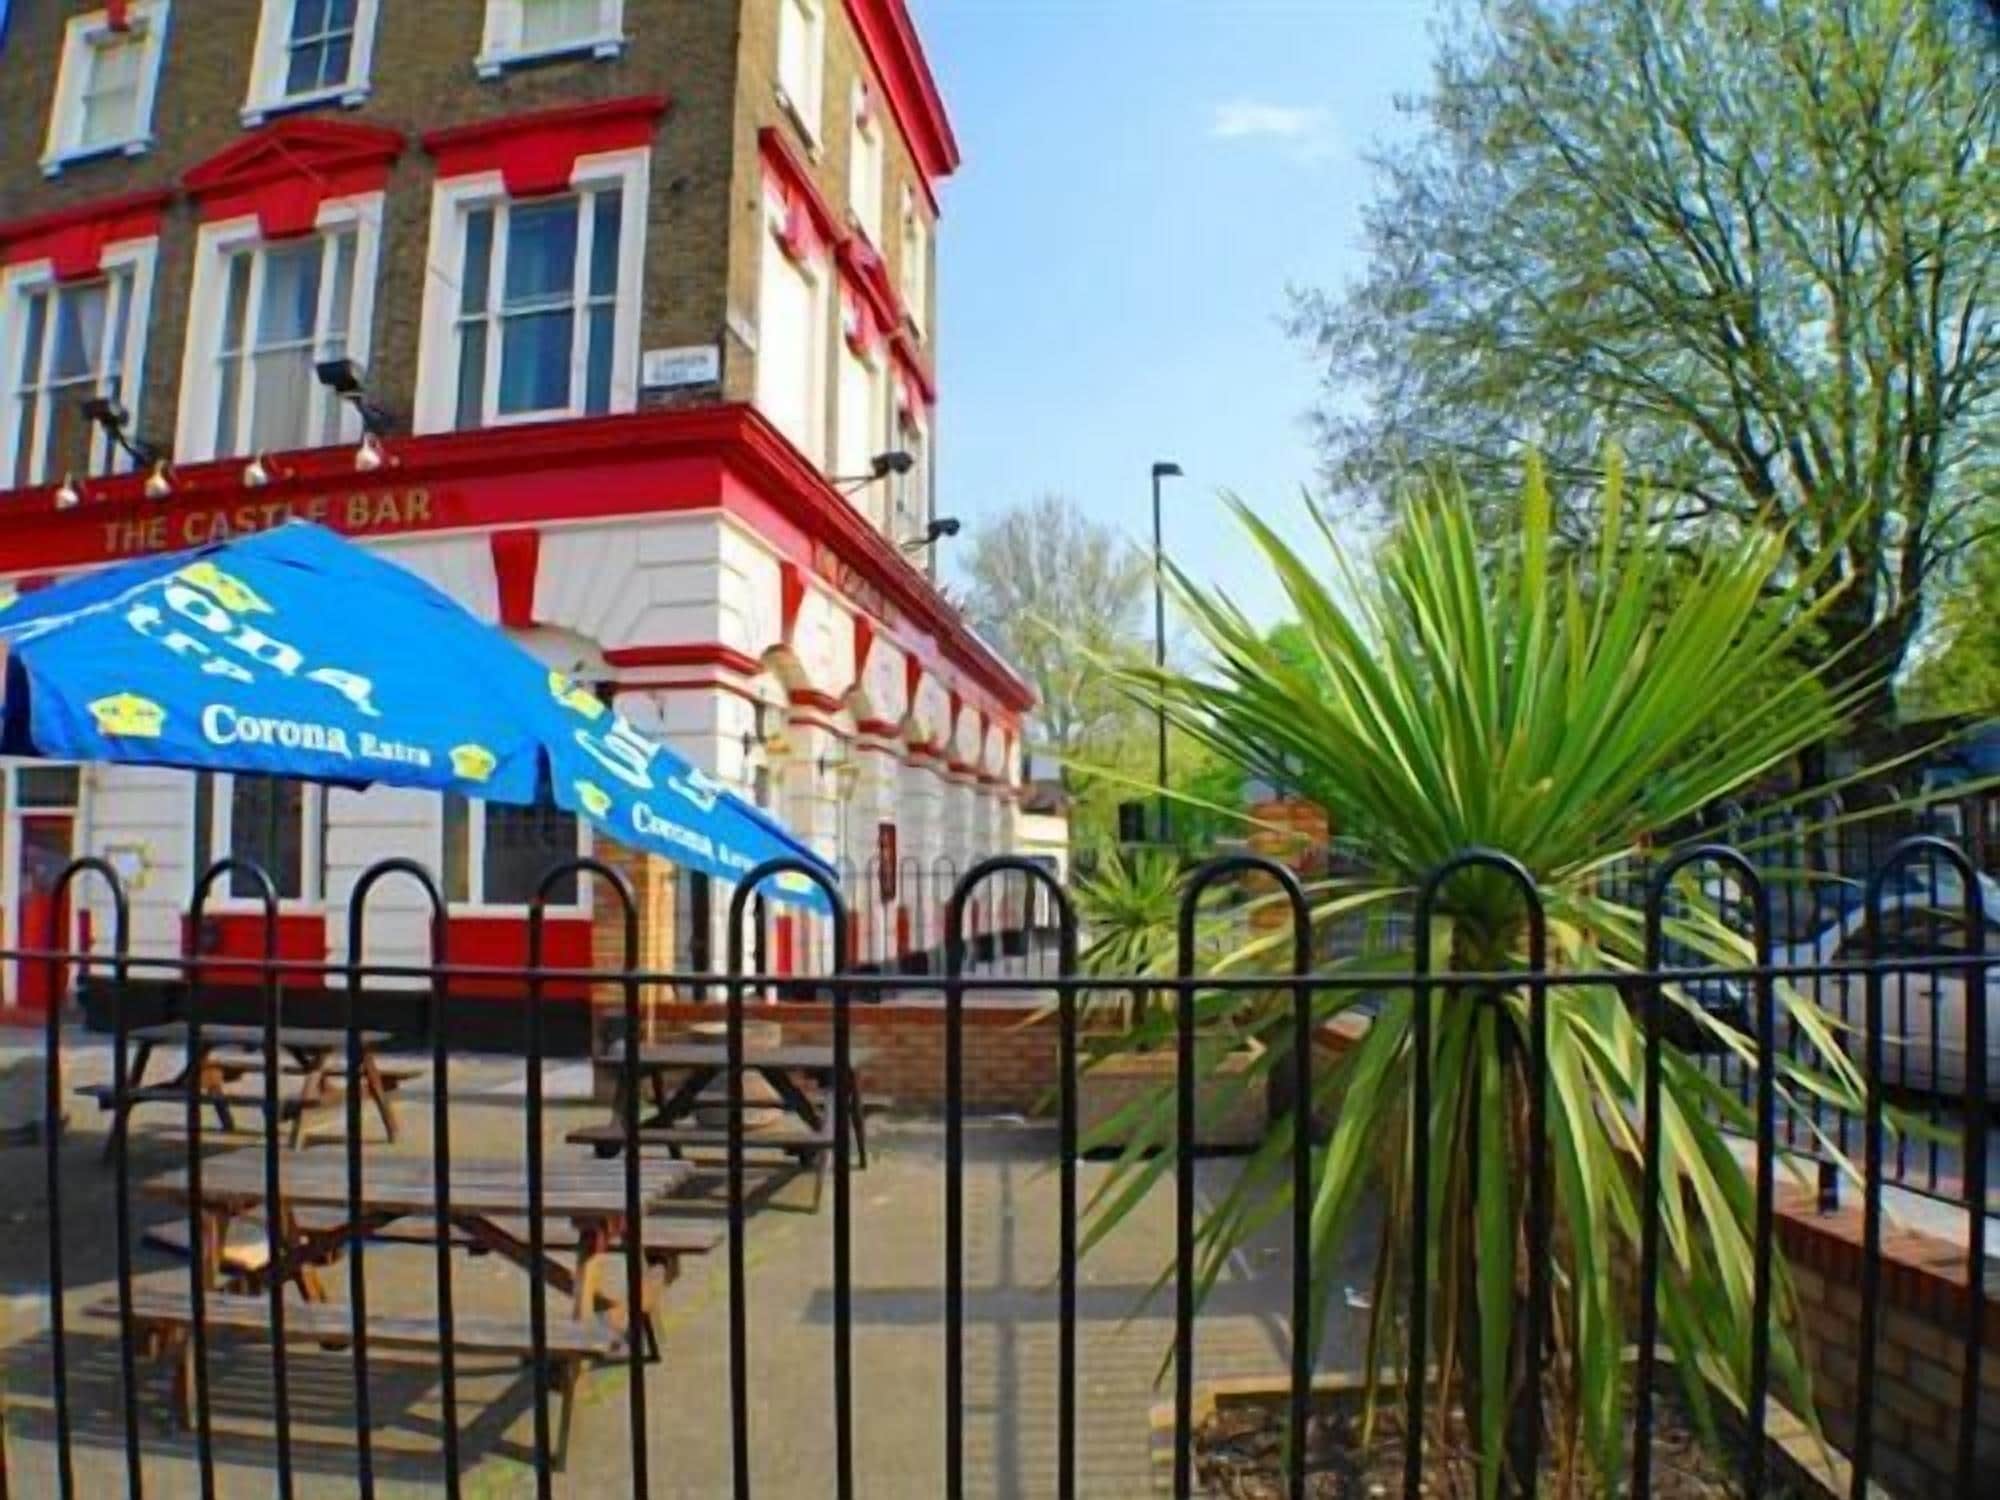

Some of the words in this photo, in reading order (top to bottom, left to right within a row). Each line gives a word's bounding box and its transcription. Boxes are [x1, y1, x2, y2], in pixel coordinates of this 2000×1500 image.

[104, 514, 168, 552] THE
[346, 487, 433, 528] BAR
[202, 703, 354, 760] Corona
